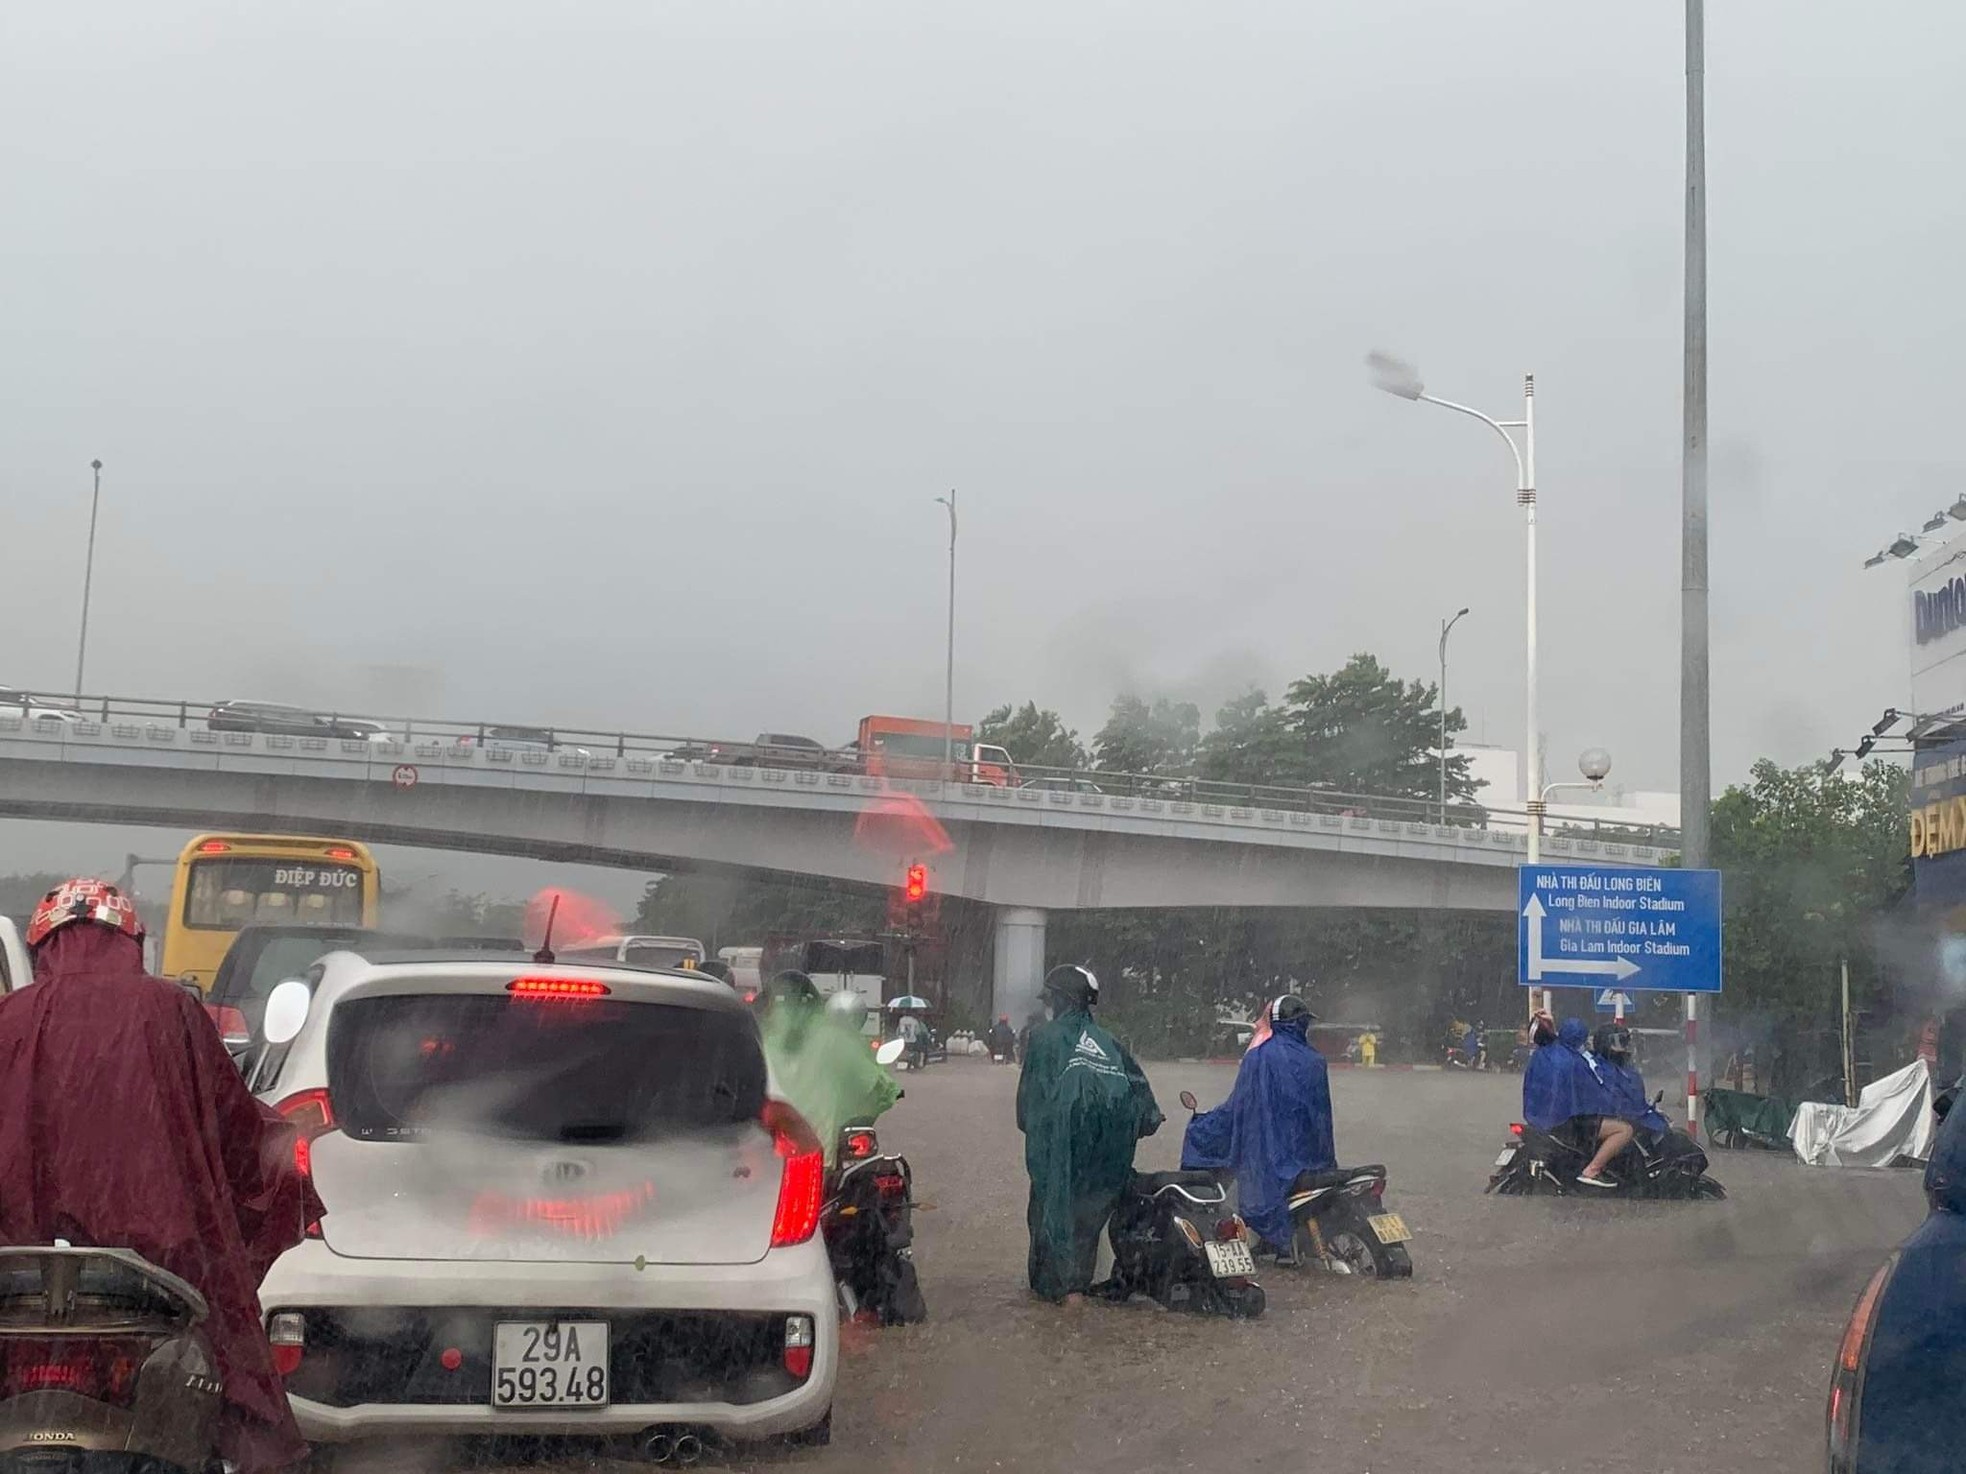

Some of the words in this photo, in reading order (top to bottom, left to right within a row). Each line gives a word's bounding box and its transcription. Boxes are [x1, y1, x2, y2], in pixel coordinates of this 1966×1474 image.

[275, 866, 315, 888] ĐIỆP
[318, 868, 357, 888] ĐỨC
[1536, 871, 1559, 889] NHÀ
[1560, 875, 1578, 890] THI
[1579, 872, 1602, 891] ĐẤU
[1603, 877, 1634, 892] LONG
[1636, 875, 1662, 892] BIÊN
[1548, 893, 1575, 911] Long
[1577, 893, 1600, 908] Bien
[1602, 895, 1636, 910] Indoor
[1639, 896, 1685, 912] Stadium
[1559, 915, 1582, 934] NHÀ
[1585, 919, 1602, 934] THI
[1628, 920, 1647, 935] GIA
[1650, 919, 1676, 936] LÂM
[1560, 938, 1578, 952] Gia
[1580, 939, 1605, 953] Lam
[1607, 939, 1642, 954] Indoor
[1644, 940, 1691, 956] Stadium
[522, 1326, 581, 1363] 29A
[497, 1365, 605, 1404] 593.48
